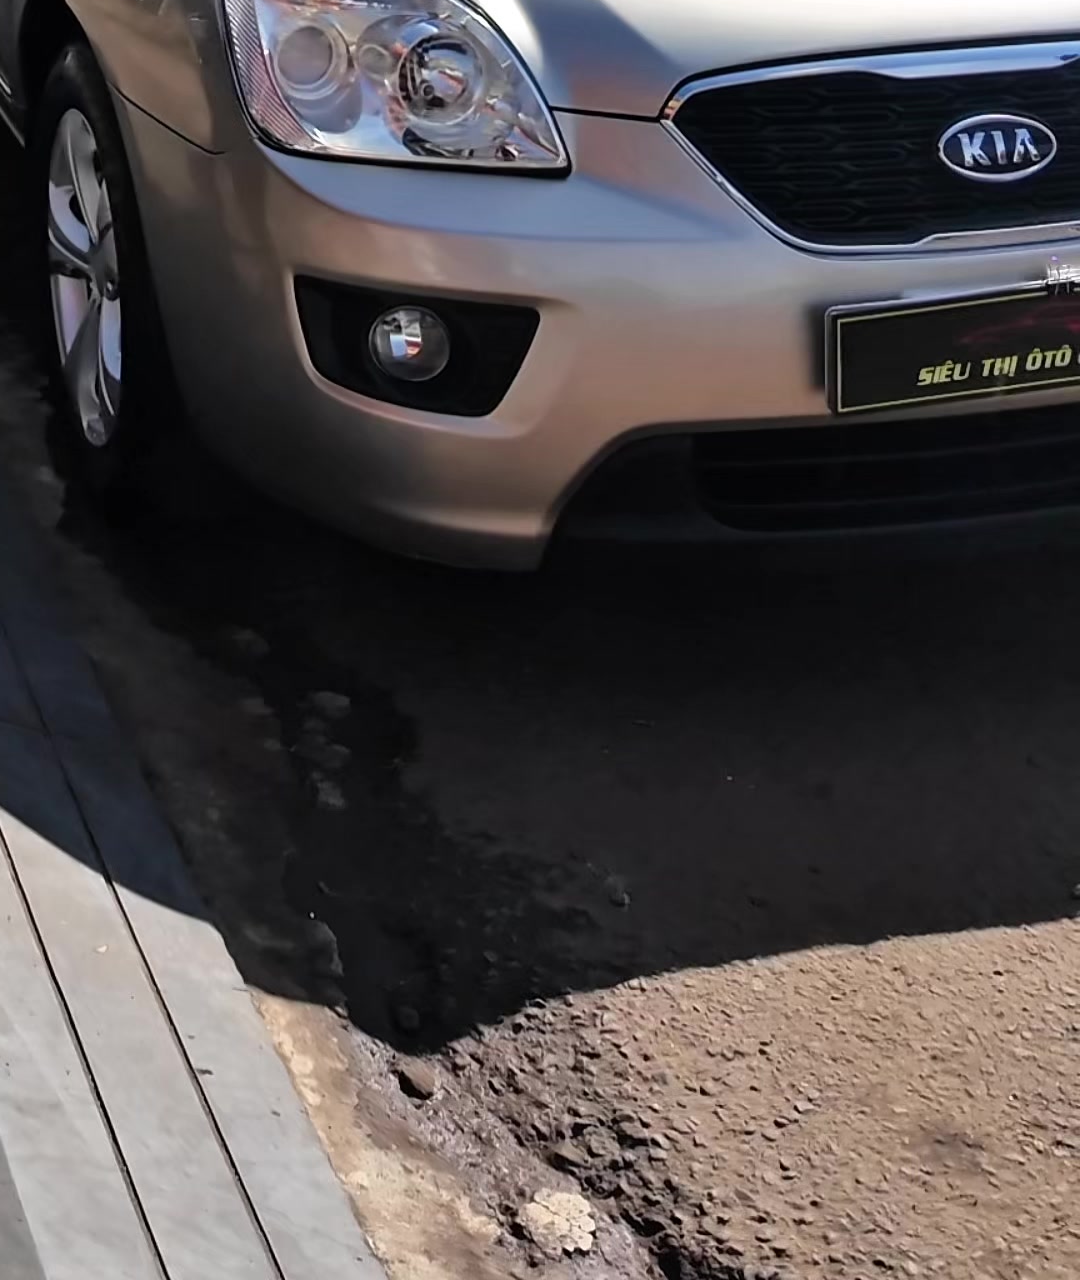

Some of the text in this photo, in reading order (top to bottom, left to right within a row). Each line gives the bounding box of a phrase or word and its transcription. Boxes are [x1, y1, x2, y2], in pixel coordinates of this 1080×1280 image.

[957, 128, 1040, 167] KIA
[917, 359, 971, 386] SIÊU
[982, 355, 1018, 377] THỊ
[1025, 344, 1073, 371] ÔTÔ
